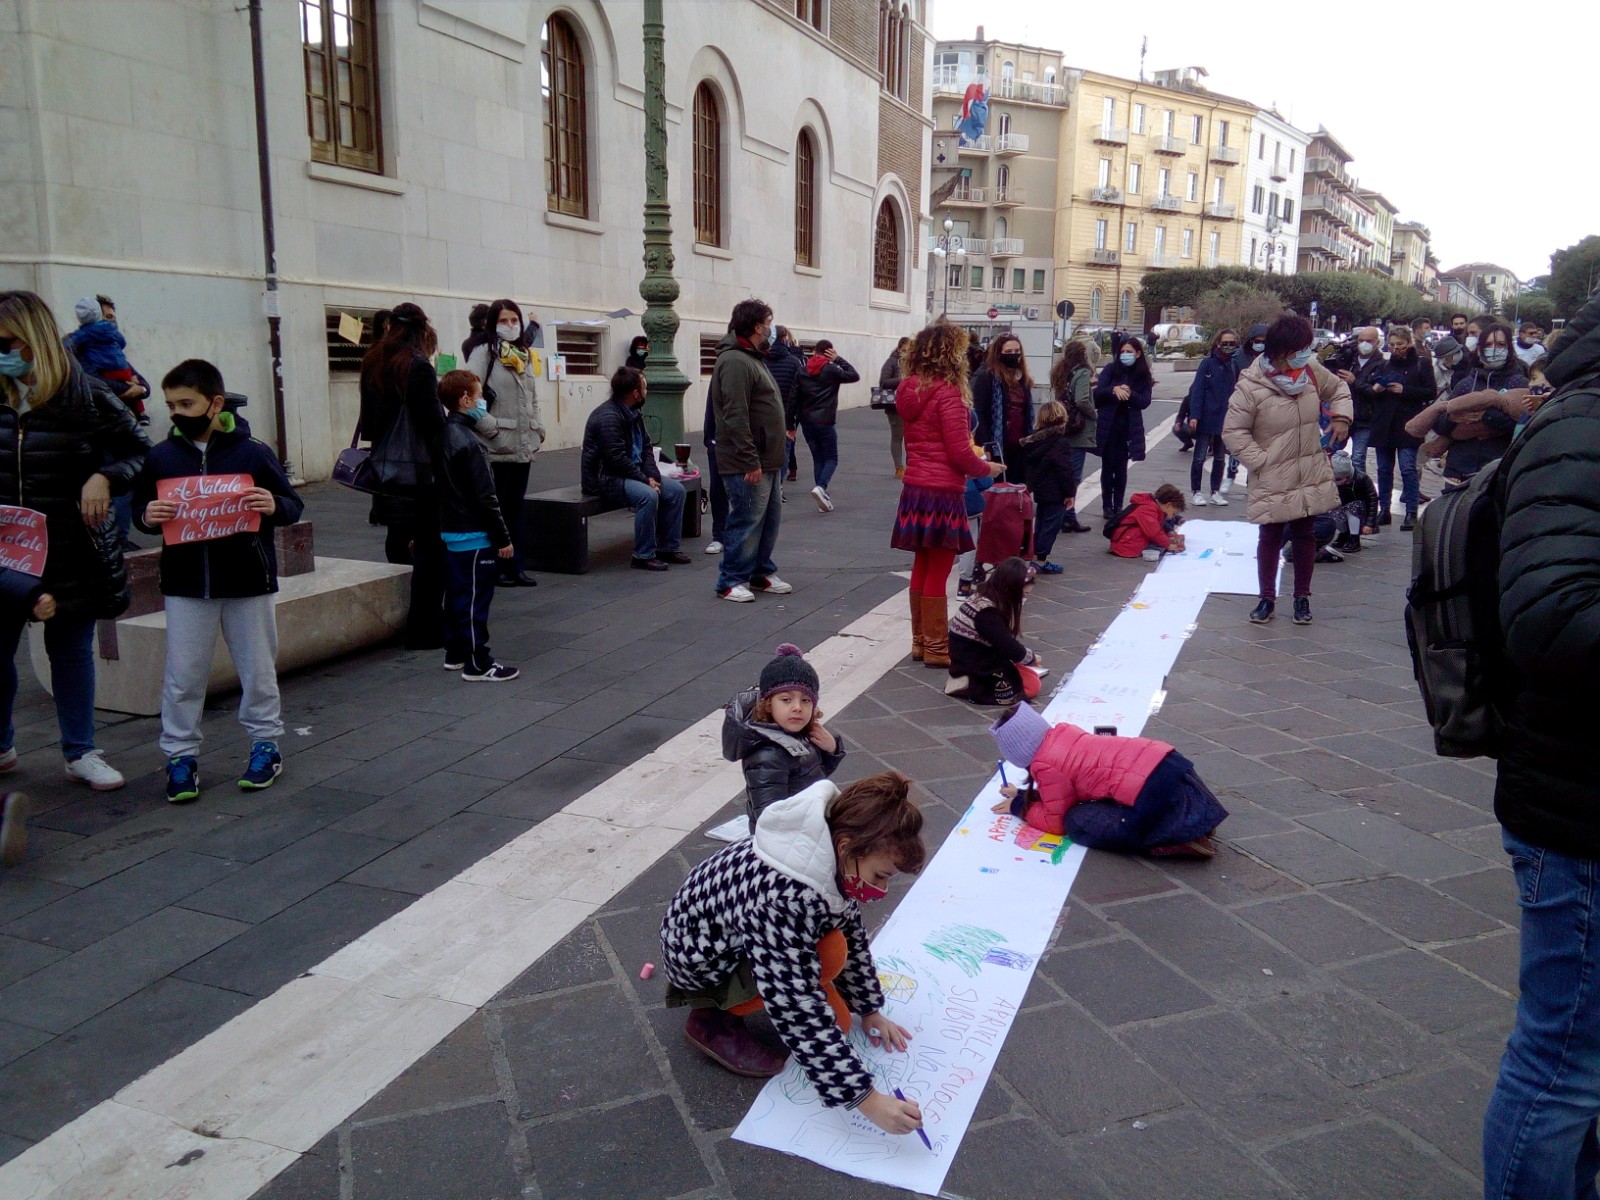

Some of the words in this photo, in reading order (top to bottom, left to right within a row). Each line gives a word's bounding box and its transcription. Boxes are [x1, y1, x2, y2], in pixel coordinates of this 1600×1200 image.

[168, 479, 190, 500] A
[187, 476, 241, 499] Natale
[175, 498, 251, 525] Regalate
[0, 531, 43, 551] alate
[181, 524, 195, 542] la
[198, 516, 249, 539] Scuola
[916, 1044, 947, 1073] NO
